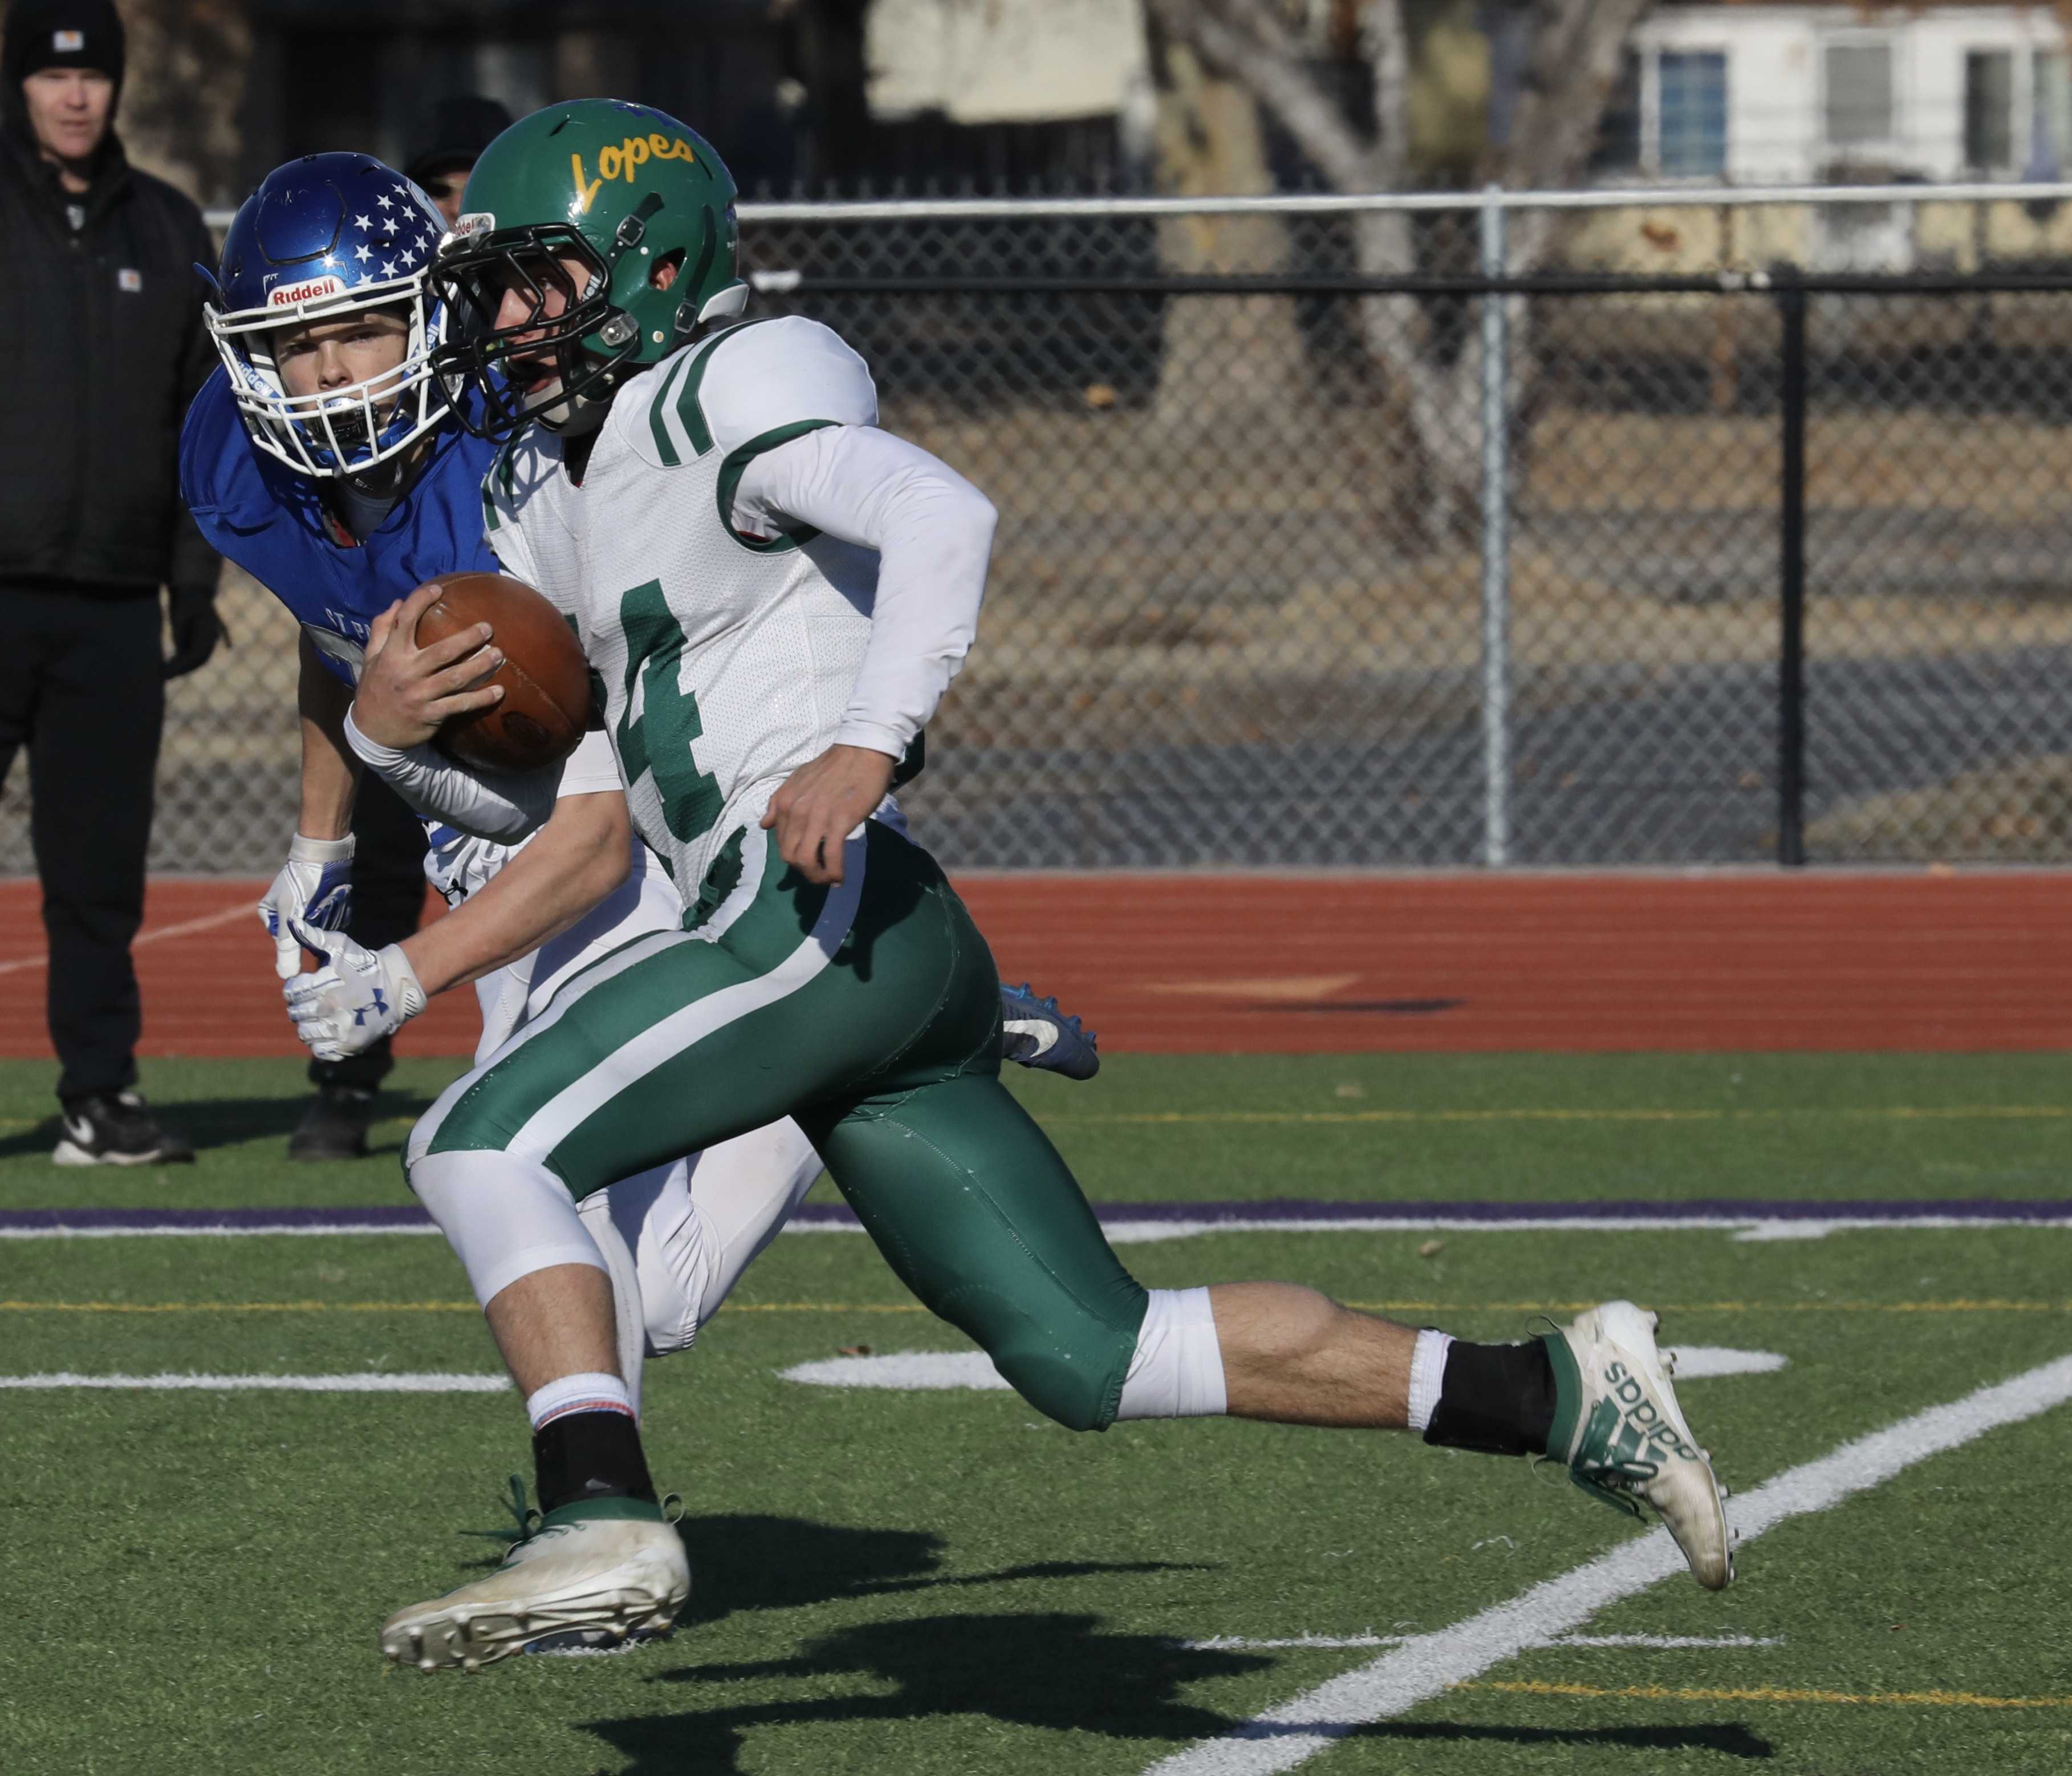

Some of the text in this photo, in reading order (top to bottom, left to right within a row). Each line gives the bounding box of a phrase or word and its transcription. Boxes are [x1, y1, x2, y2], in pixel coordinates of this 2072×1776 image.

[273, 279, 335, 305] Riddell
[325, 607, 346, 633] ST
[564, 578, 725, 879] 4
[1604, 1361, 1698, 1460] adidas
